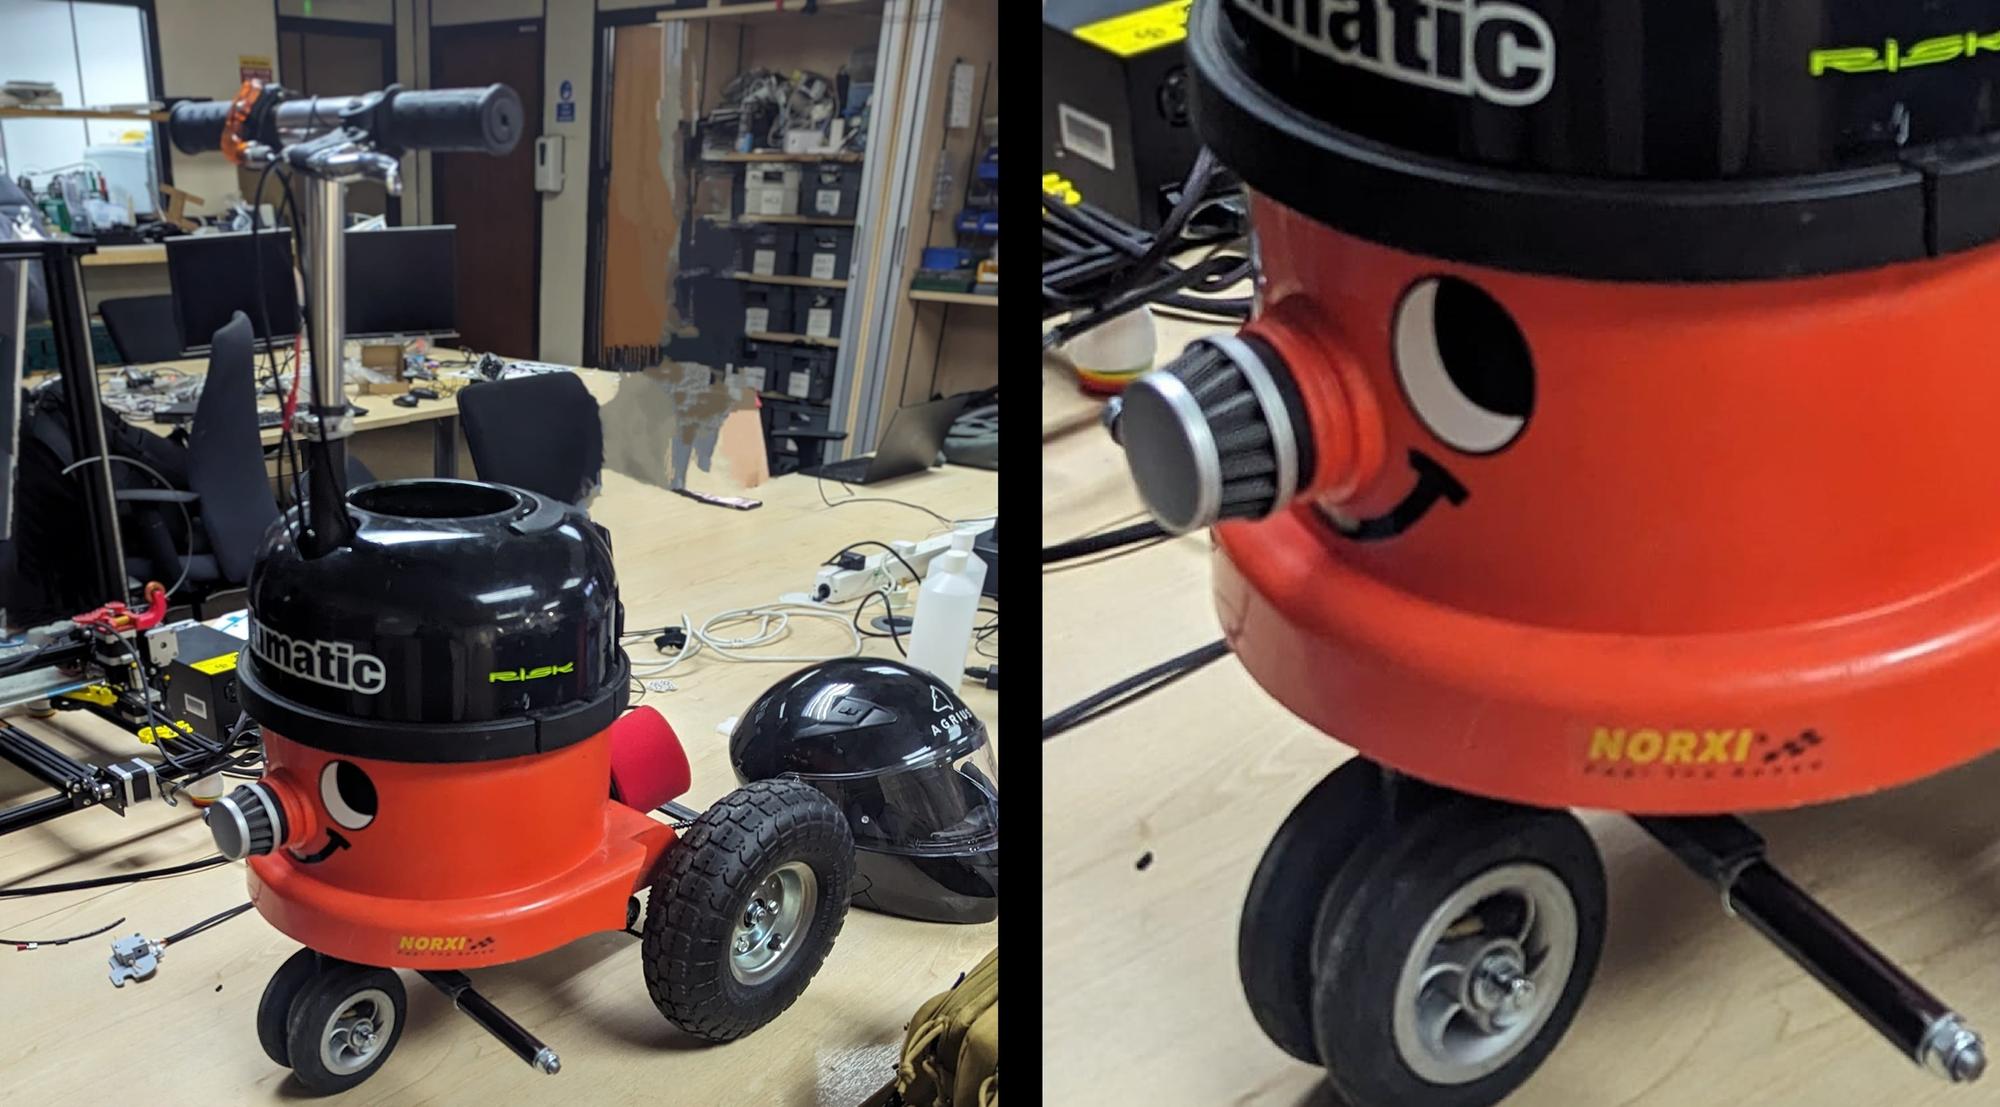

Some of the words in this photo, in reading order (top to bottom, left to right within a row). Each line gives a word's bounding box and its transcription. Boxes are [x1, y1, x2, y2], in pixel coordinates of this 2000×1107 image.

[488, 661, 574, 683] RISK
[930, 708, 973, 737] AGRIUS
[1588, 726, 1753, 764] NORXI
[400, 935, 467, 951] NORXI
